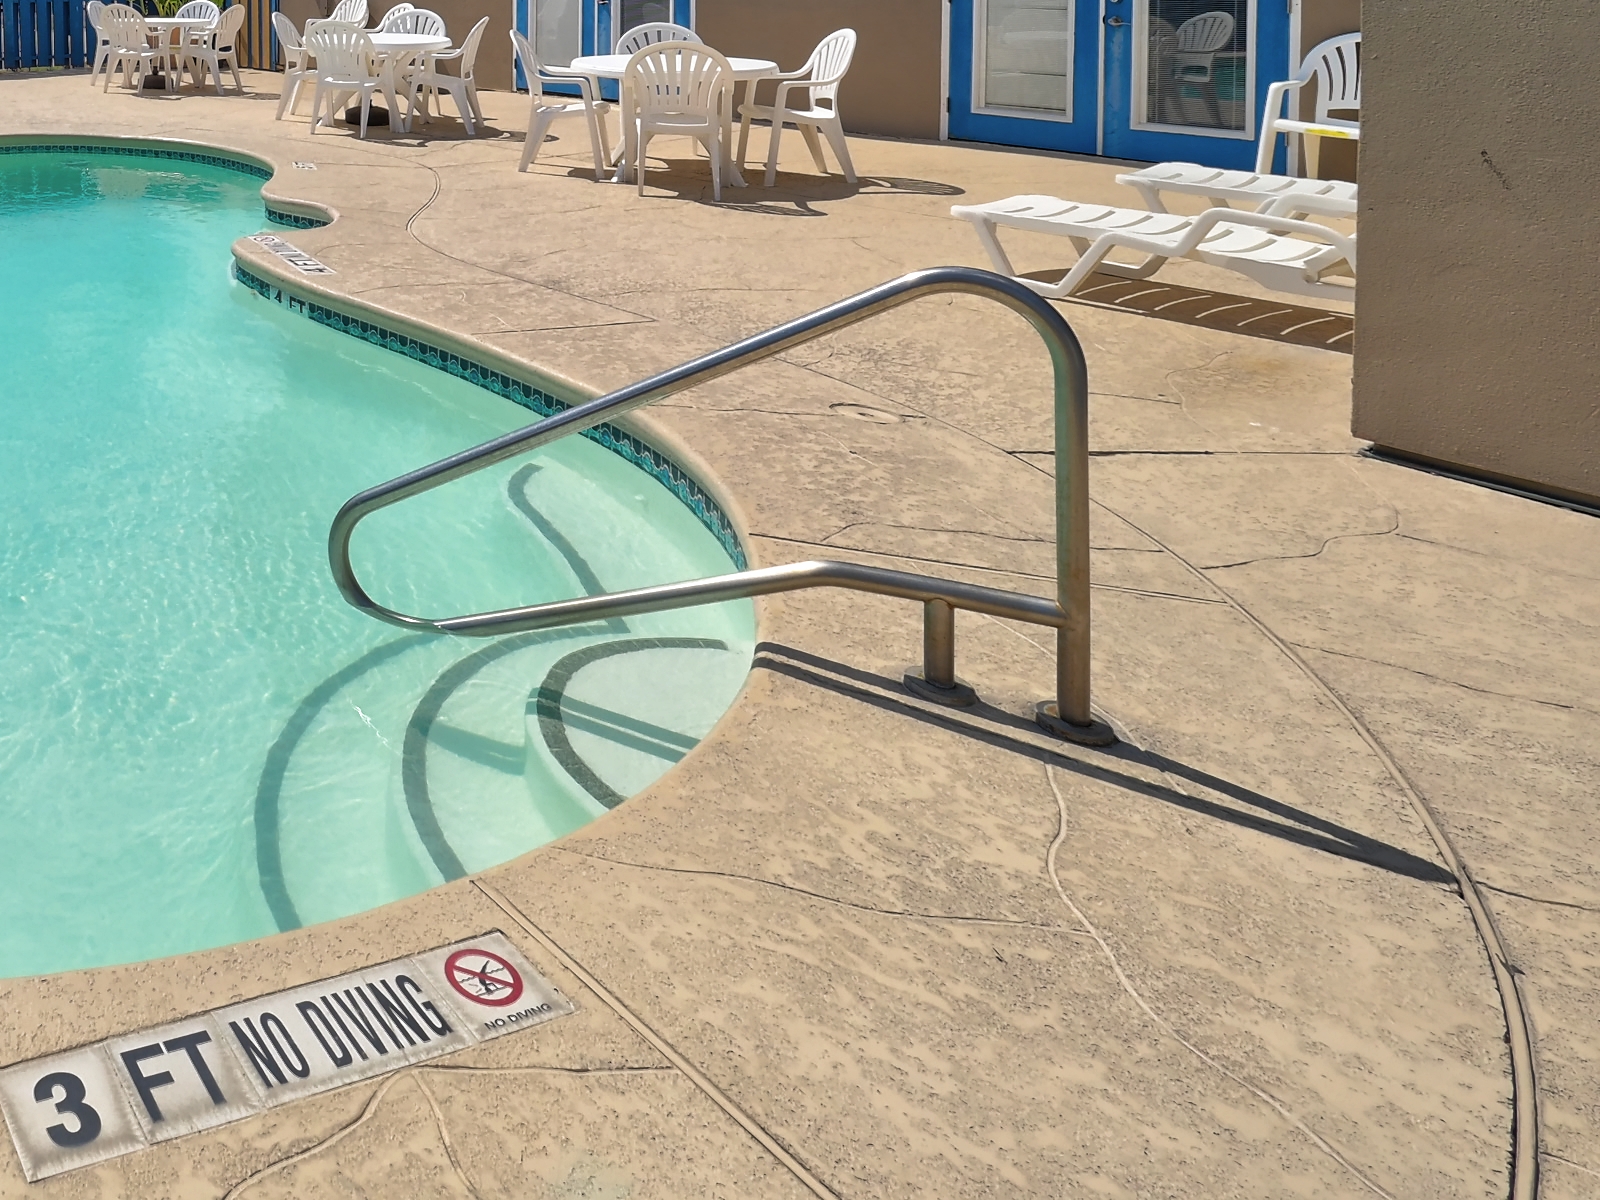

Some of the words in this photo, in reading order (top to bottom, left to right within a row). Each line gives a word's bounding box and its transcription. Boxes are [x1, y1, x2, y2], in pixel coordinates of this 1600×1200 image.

[274, 289, 283, 304] 4
[289, 295, 306, 314] FT
[484, 1018, 506, 1030] NO
[507, 1003, 553, 1023] DIVING
[33, 1071, 102, 1148] 3
[120, 1030, 228, 1124] FT
[228, 1012, 311, 1089] NO
[294, 974, 454, 1069] DIVING
